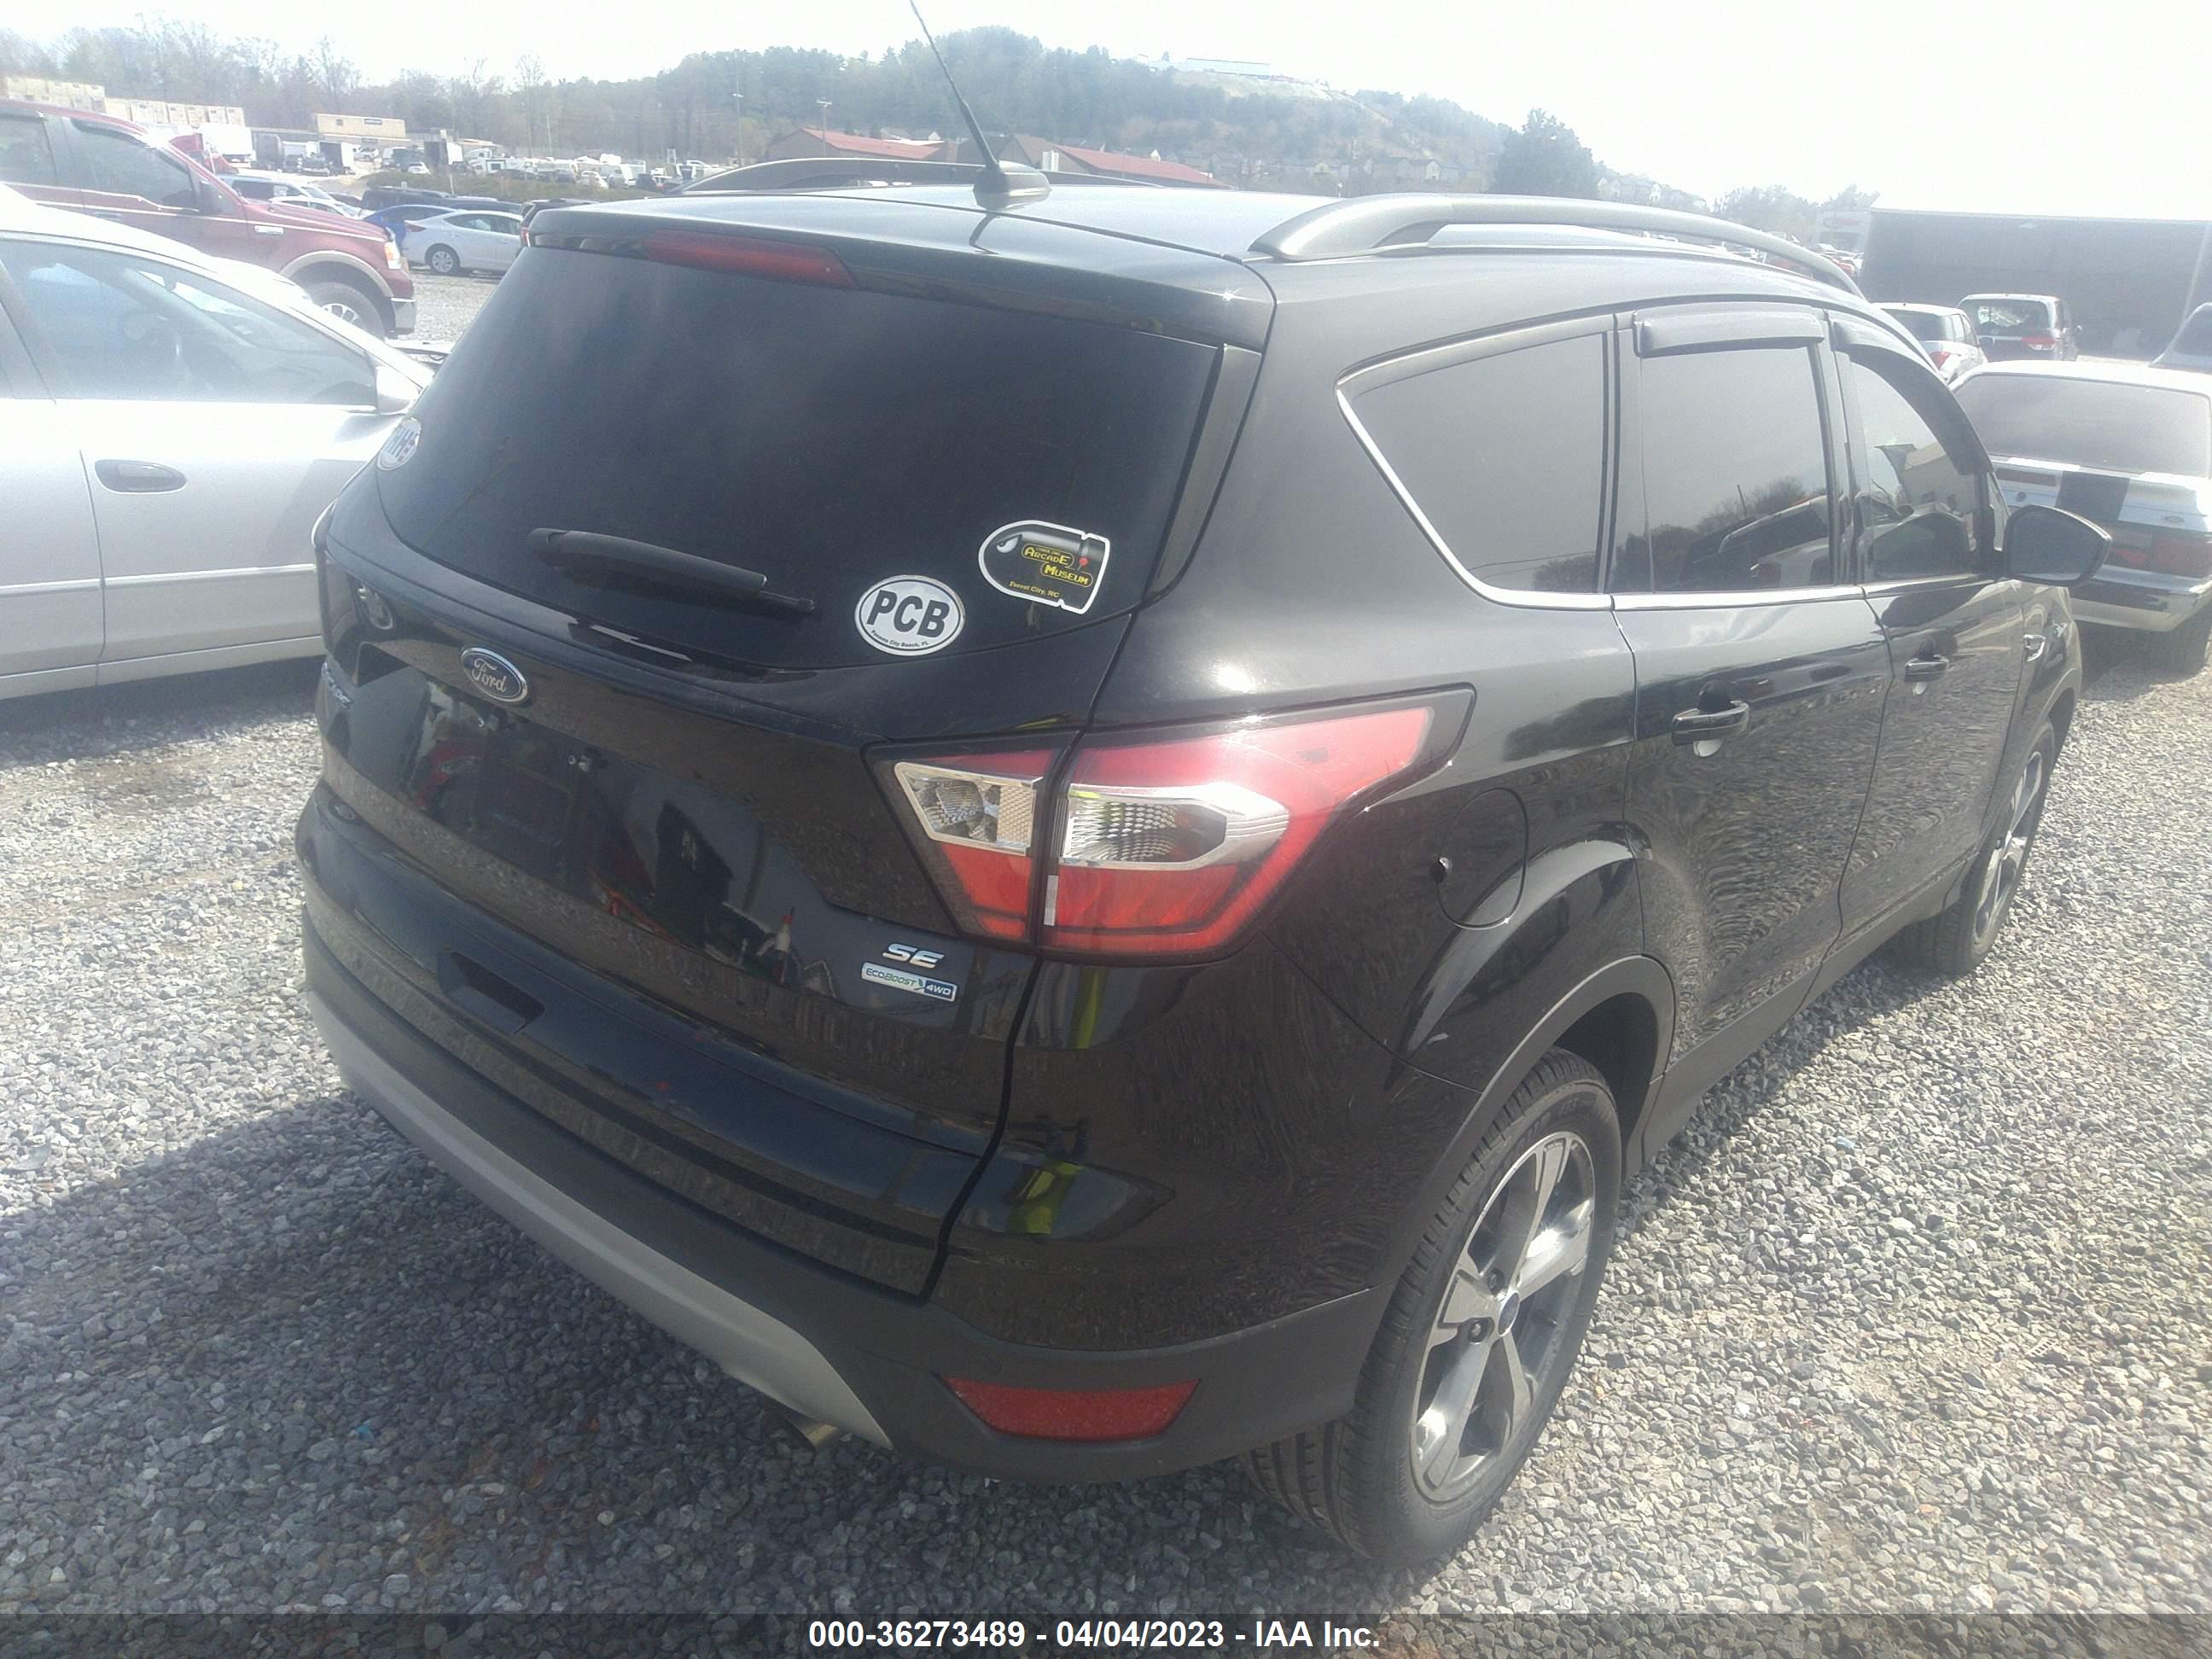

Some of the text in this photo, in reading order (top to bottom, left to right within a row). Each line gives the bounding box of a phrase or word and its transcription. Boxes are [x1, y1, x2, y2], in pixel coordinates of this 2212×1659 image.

[1044, 564, 1089, 585] MUSEUM
[867, 590, 951, 638] PCB
[472, 658, 507, 692] Ford
[882, 943, 946, 969] SE
[926, 984, 952, 996] 4WD
